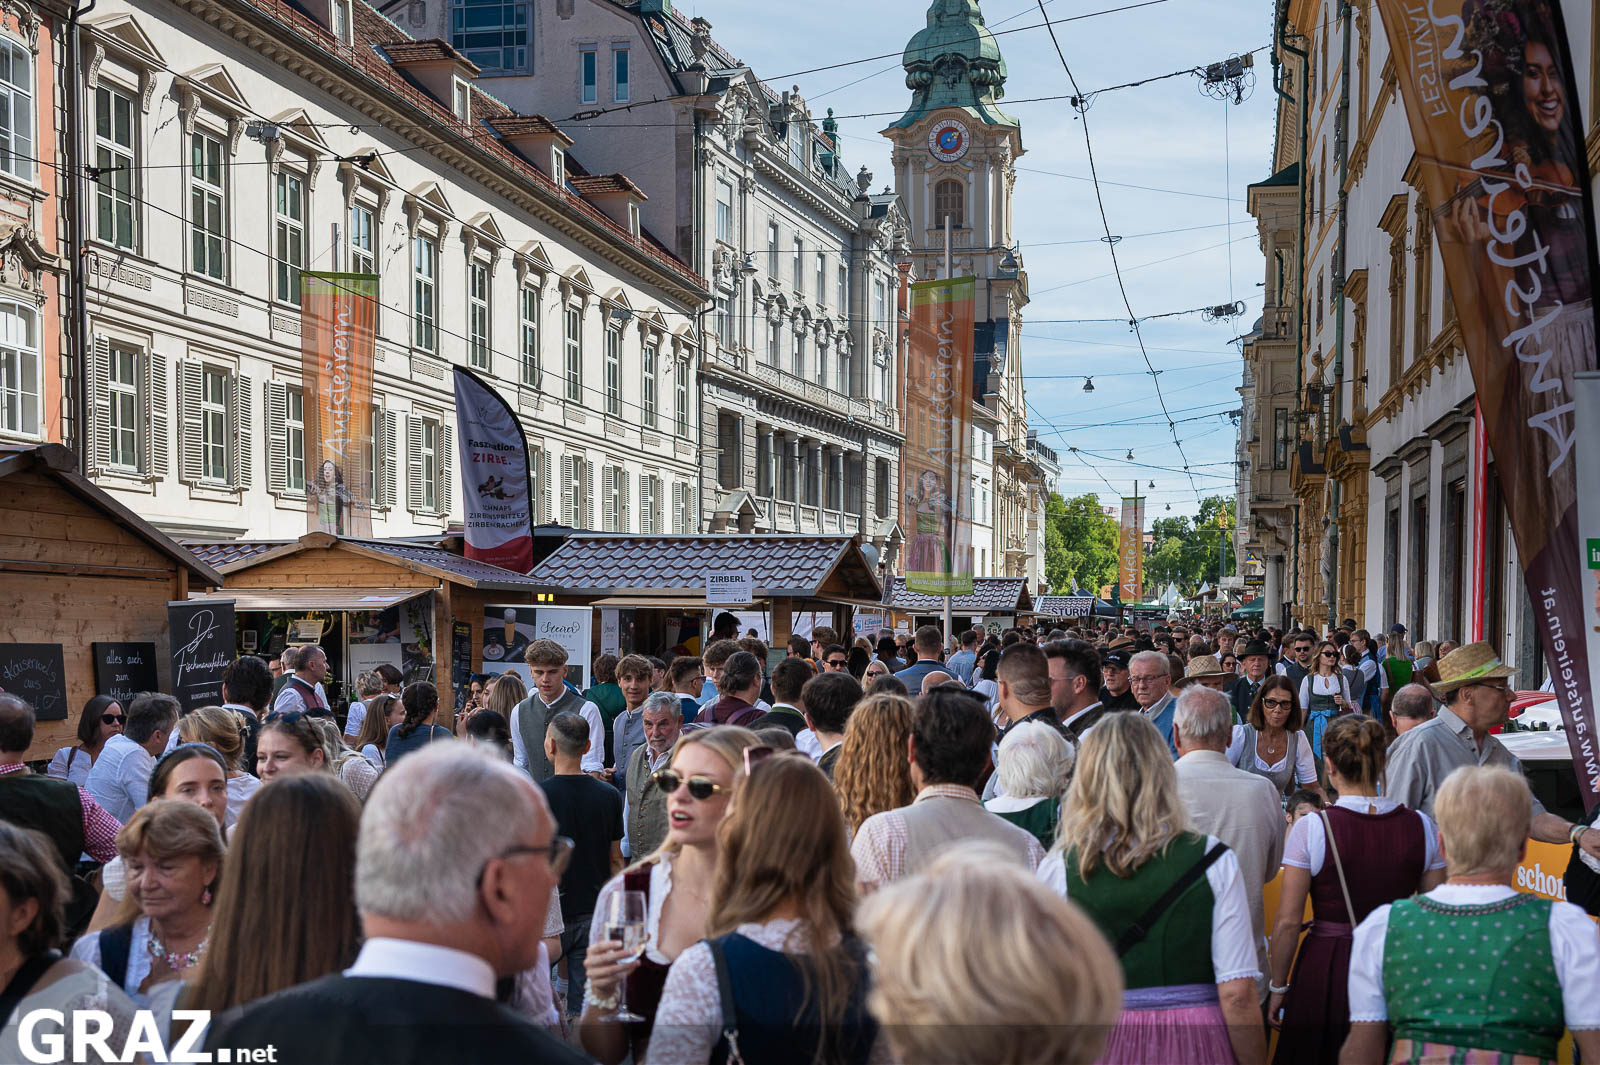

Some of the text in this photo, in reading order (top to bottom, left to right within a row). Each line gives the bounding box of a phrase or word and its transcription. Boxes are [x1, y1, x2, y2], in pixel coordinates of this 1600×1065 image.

[325, 303, 353, 460] Aufsteirern
[926, 311, 956, 469] Aufsteirern
[468, 439, 516, 452] Faszation
[472, 452, 512, 465] ZIRBE.
[709, 575, 746, 583] ZIRBERL
[1051, 607, 1088, 616] STURM
[106, 649, 143, 665] alles auch
[24, 678, 41, 689] aus
[115, 673, 130, 681] zum
[110, 687, 137, 701] Mitneh
